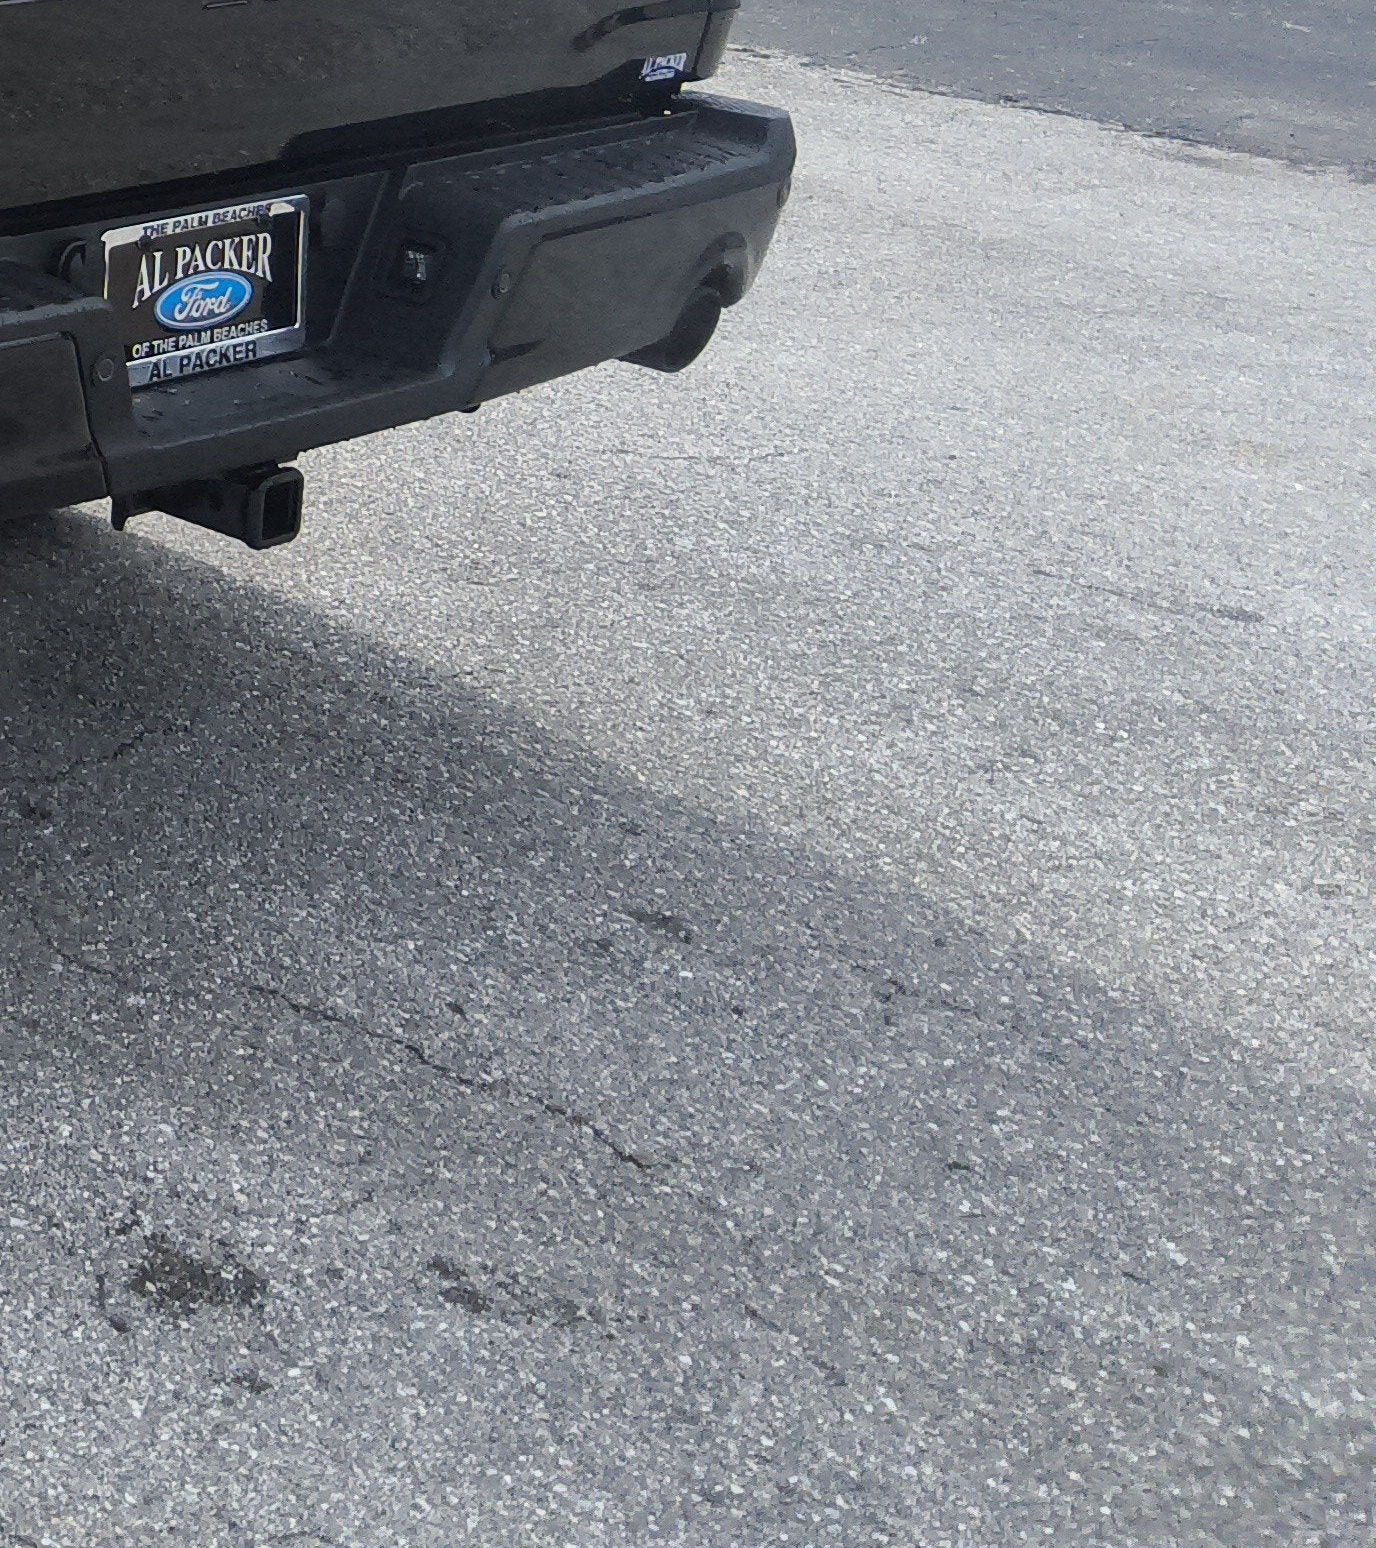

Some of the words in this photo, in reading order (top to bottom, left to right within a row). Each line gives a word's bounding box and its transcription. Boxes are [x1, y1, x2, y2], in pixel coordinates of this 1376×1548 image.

[142, 221, 170, 239] THE
[171, 214, 209, 234] PALM
[132, 251, 169, 308] AL
[174, 232, 273, 283] PACKER
[173, 281, 233, 321] Ford
[132, 341, 151, 359] OF
[151, 336, 177, 354] THE
[178, 328, 212, 350] PALM
[213, 318, 269, 341] BEACHES
[147, 361, 174, 382] AL
[178, 339, 258, 375] PACKER
